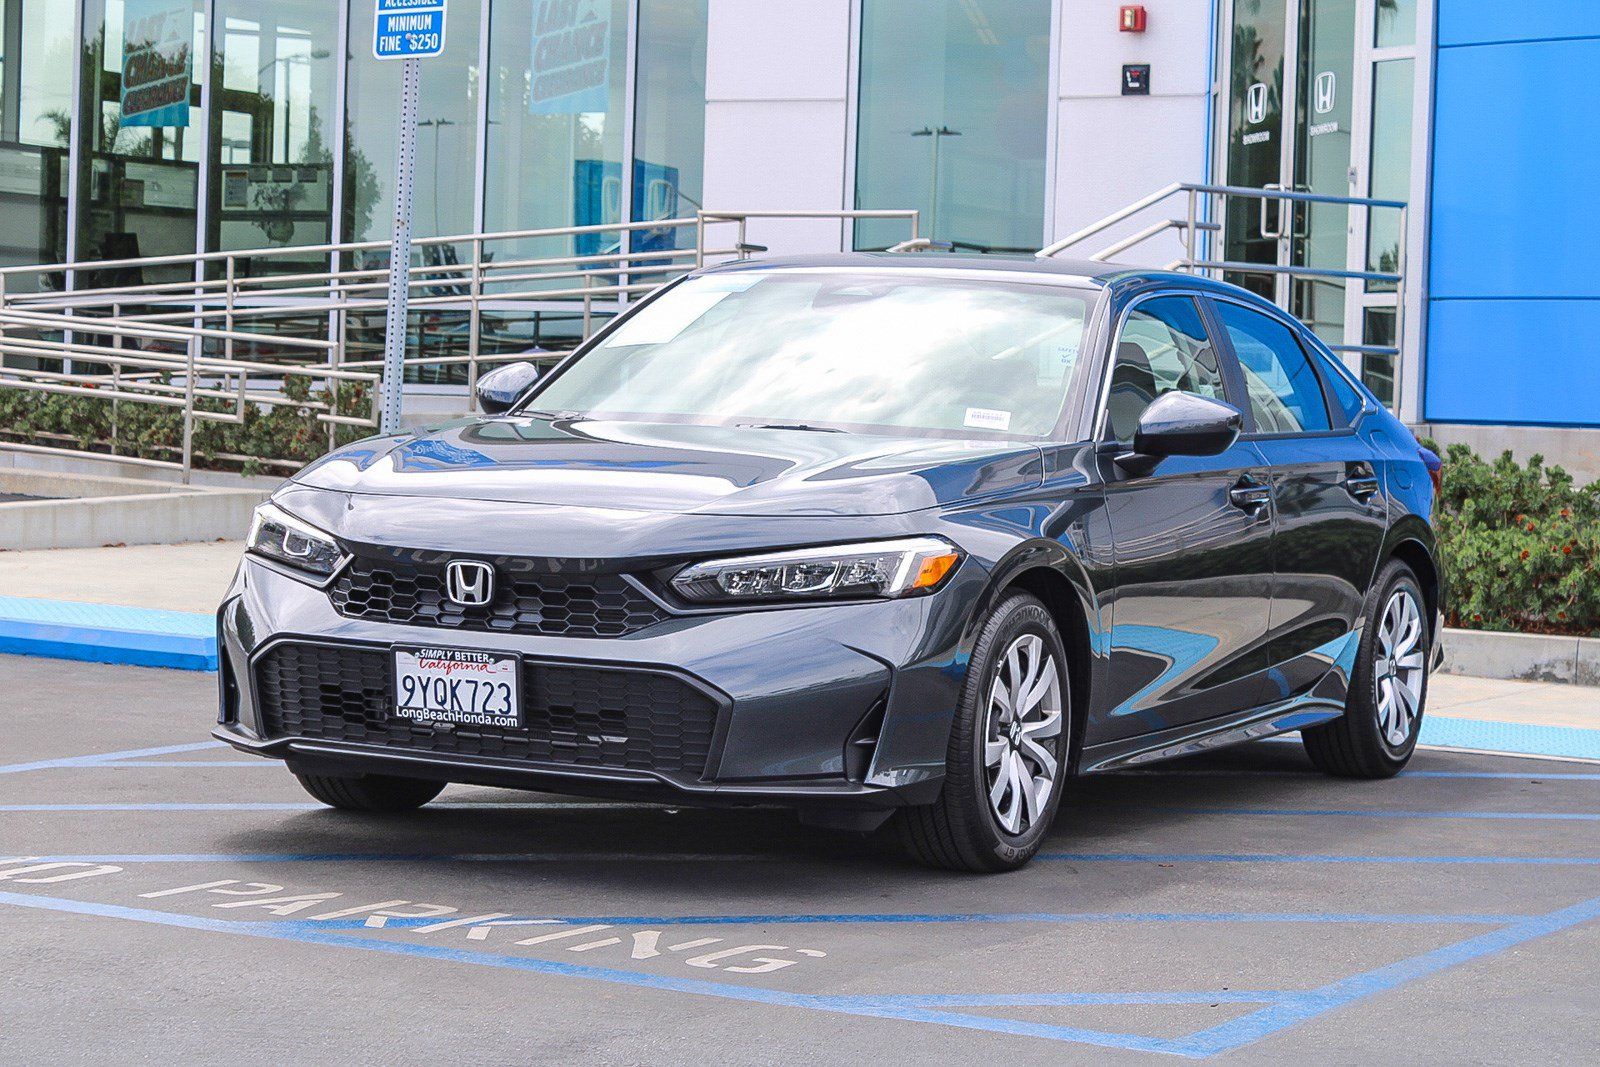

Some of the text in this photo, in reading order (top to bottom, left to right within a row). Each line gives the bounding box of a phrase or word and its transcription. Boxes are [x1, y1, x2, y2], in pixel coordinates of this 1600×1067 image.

[387, 14, 432, 32] MINIMUM
[379, 32, 438, 52] FINE $250
[1309, 121, 1339, 136] SHOWROOM
[1242, 131, 1270, 145] SHOWROOM
[419, 649, 489, 663] SIMPLY BETTER
[419, 658, 497, 676] California
[402, 674, 512, 715] 9YQK723
[396, 705, 518, 728] LongBeachHonda.com
[138, 879, 827, 974] PARKING
